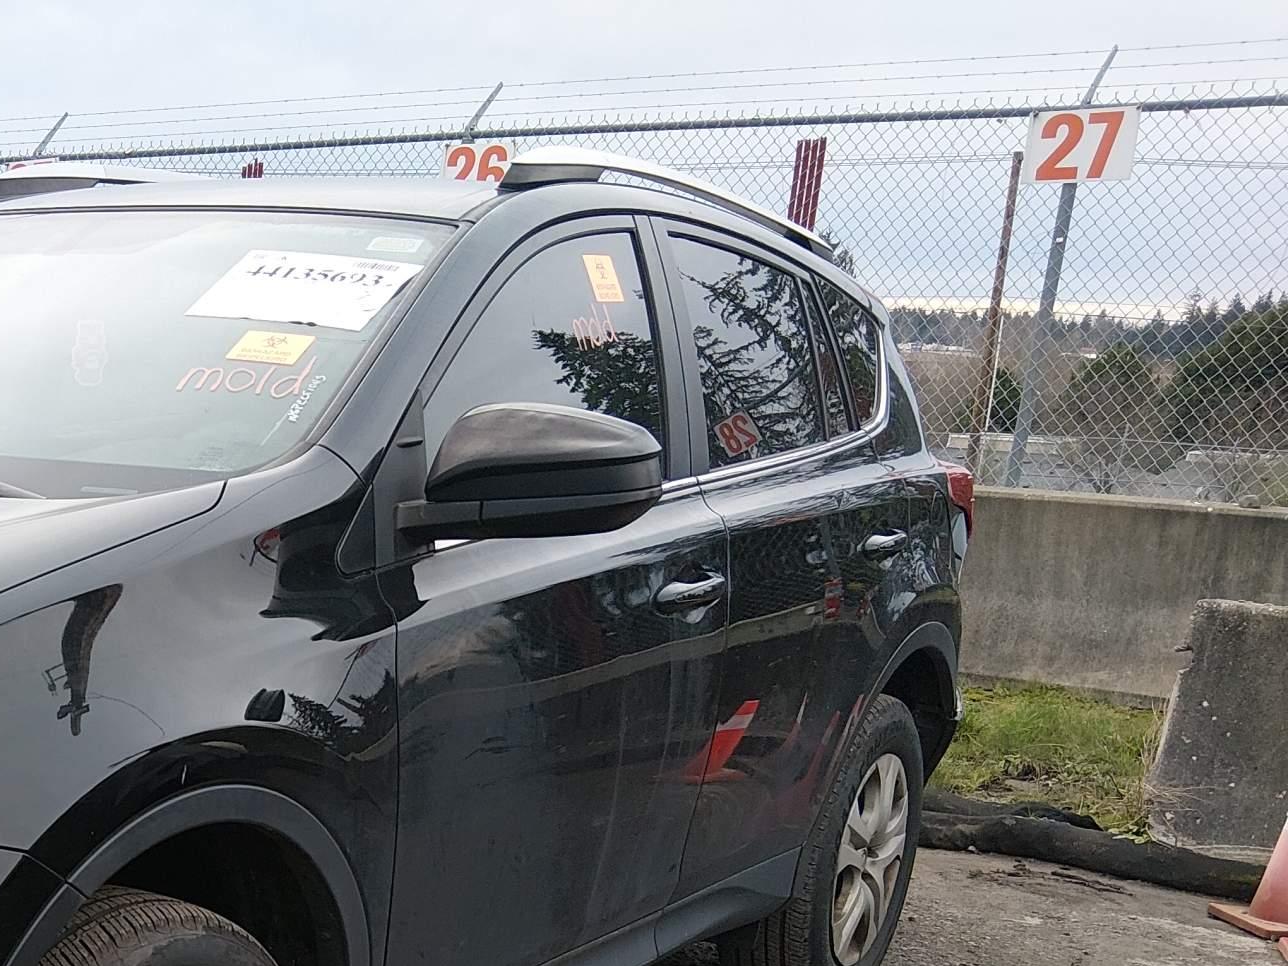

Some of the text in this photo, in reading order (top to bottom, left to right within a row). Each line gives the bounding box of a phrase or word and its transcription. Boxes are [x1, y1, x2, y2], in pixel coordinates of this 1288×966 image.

[446, 144, 508, 182] 26
[1034, 110, 1126, 181] 27
[175, 355, 318, 399] mold
